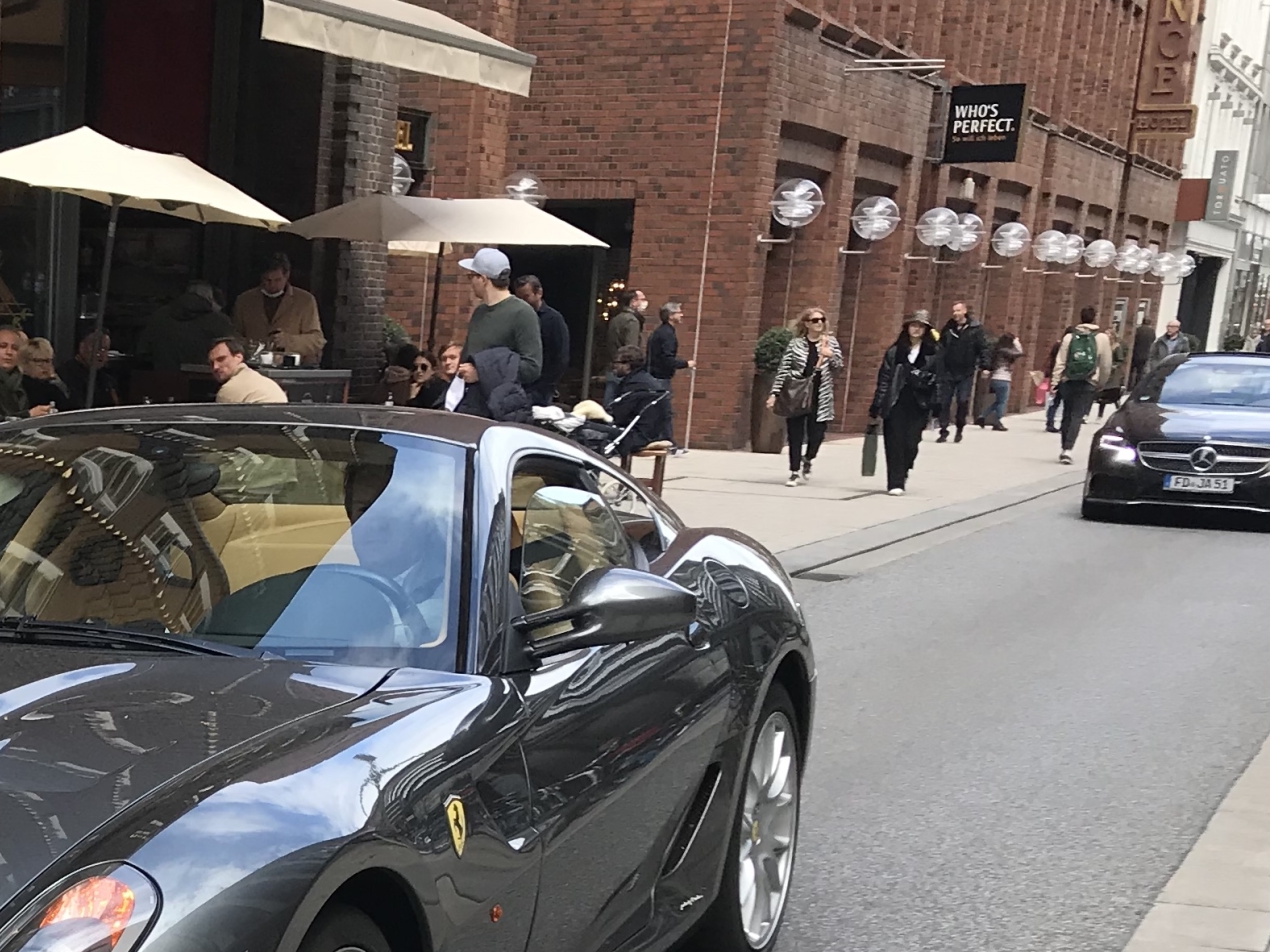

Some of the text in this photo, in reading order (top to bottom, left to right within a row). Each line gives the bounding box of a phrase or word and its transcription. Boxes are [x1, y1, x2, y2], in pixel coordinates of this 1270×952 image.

[955, 104, 999, 118] WHO'S
[1136, 115, 1187, 131] HOTEL
[1174, 477, 1190, 488] FD
[1197, 478, 1212, 489] JA
[1214, 479, 1228, 490] 51
